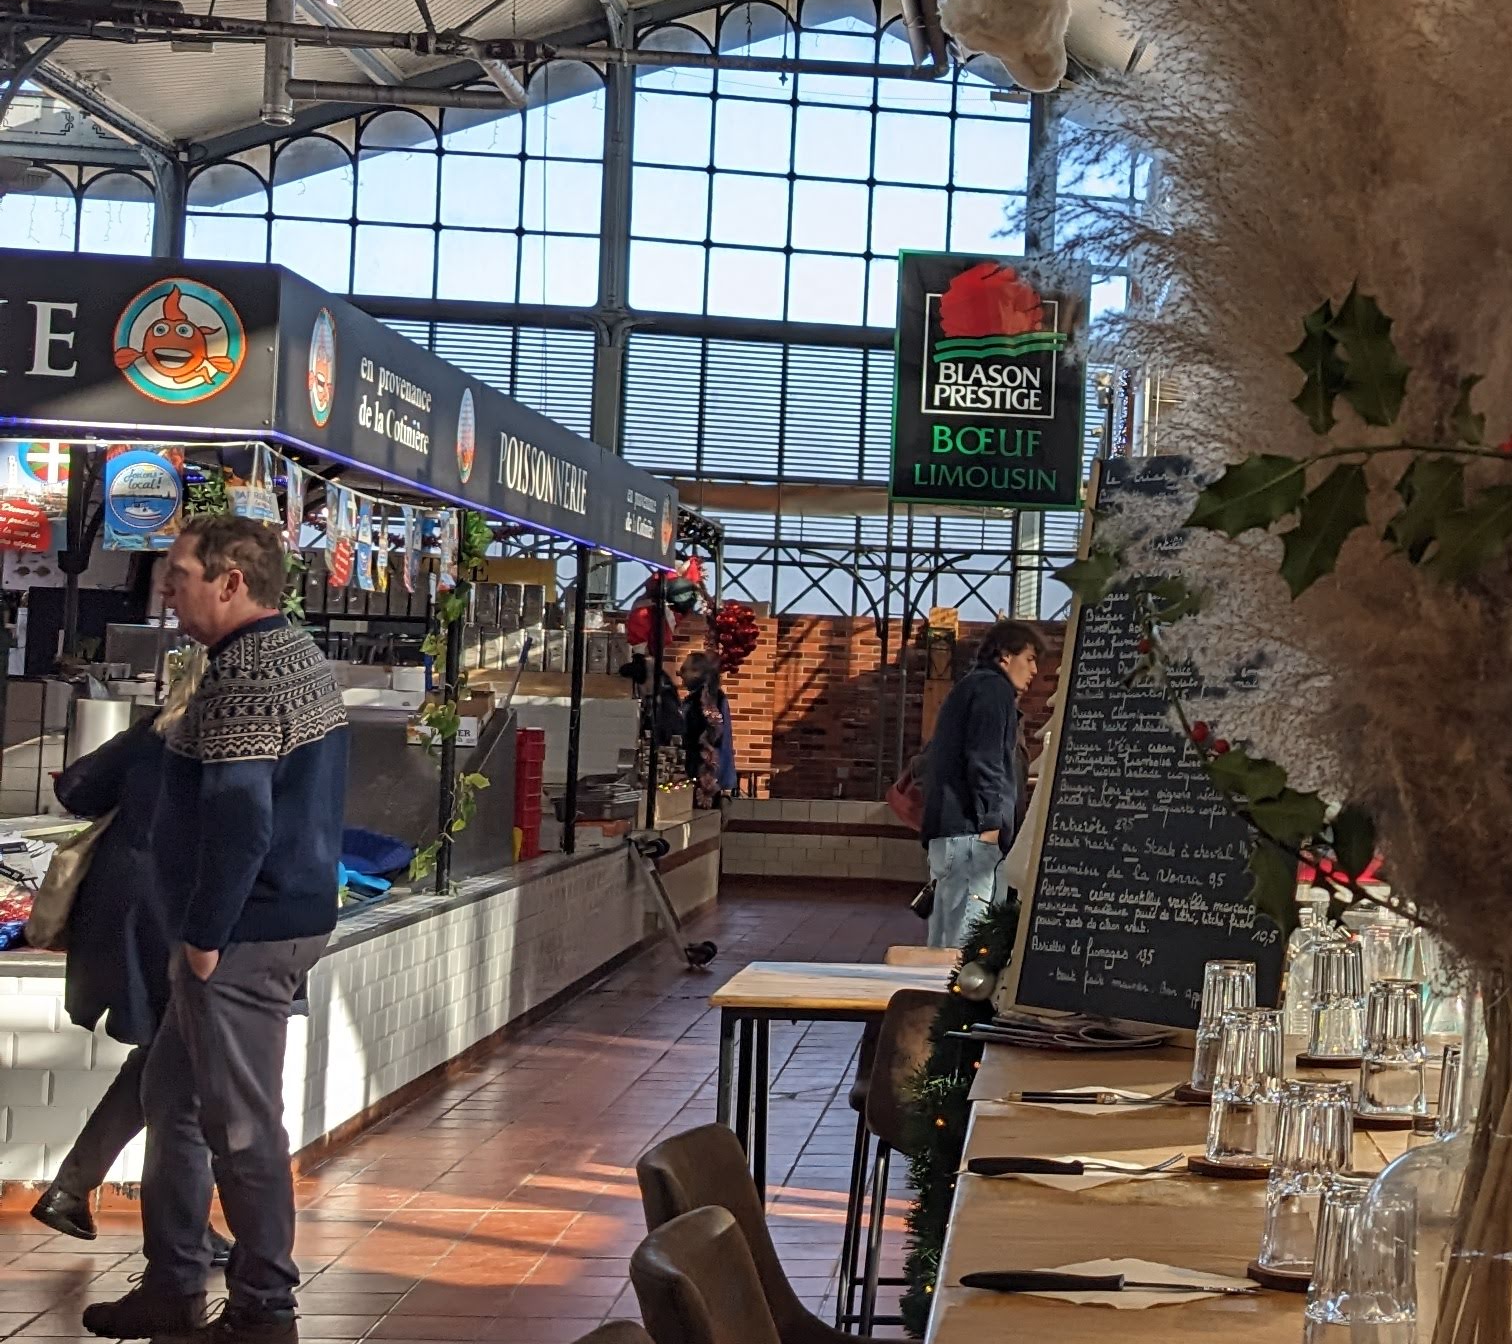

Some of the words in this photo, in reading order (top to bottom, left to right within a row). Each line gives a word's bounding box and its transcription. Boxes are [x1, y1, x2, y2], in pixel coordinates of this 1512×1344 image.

[360, 356, 374, 382] en
[377, 367, 432, 413] provenance
[938, 362, 1041, 388] BLASON
[933, 385, 1043, 411] PRESTIGE
[359, 395, 373, 428] de
[373, 401, 384, 434] la
[386, 409, 430, 455] Cotinière
[932, 424, 1042, 457] BŒUF
[497, 432, 588, 516] POISSONNERIE
[914, 463, 1057, 492] LIMOUSIN
[1047, 833, 1081, 848] Steak
[1143, 837, 1176, 856] Steak
[1042, 856, 1100, 876] Tiramisu
[1106, 864, 1125, 879] de
[1131, 863, 1150, 881] la
[1071, 939, 1082, 955] de
[1251, 929, 1279, 948] 10,5
